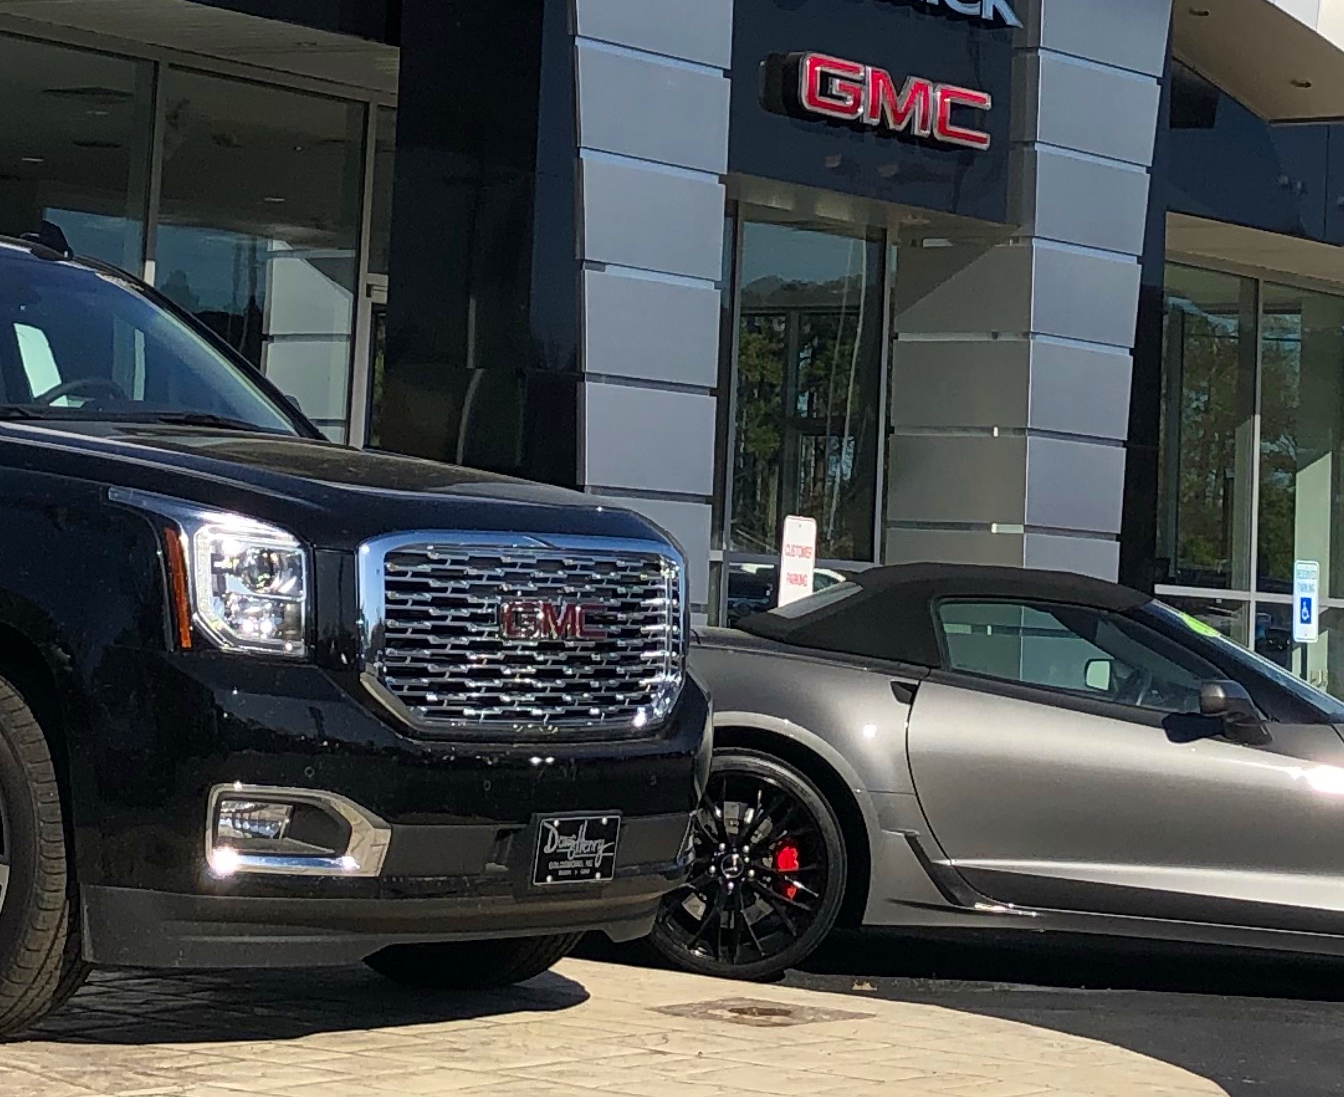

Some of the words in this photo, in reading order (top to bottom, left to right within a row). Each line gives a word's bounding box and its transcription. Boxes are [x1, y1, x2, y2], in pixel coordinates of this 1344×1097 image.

[799, 51, 992, 151] GMC
[499, 599, 609, 640] GMC
[572, 819, 616, 869] Henry
